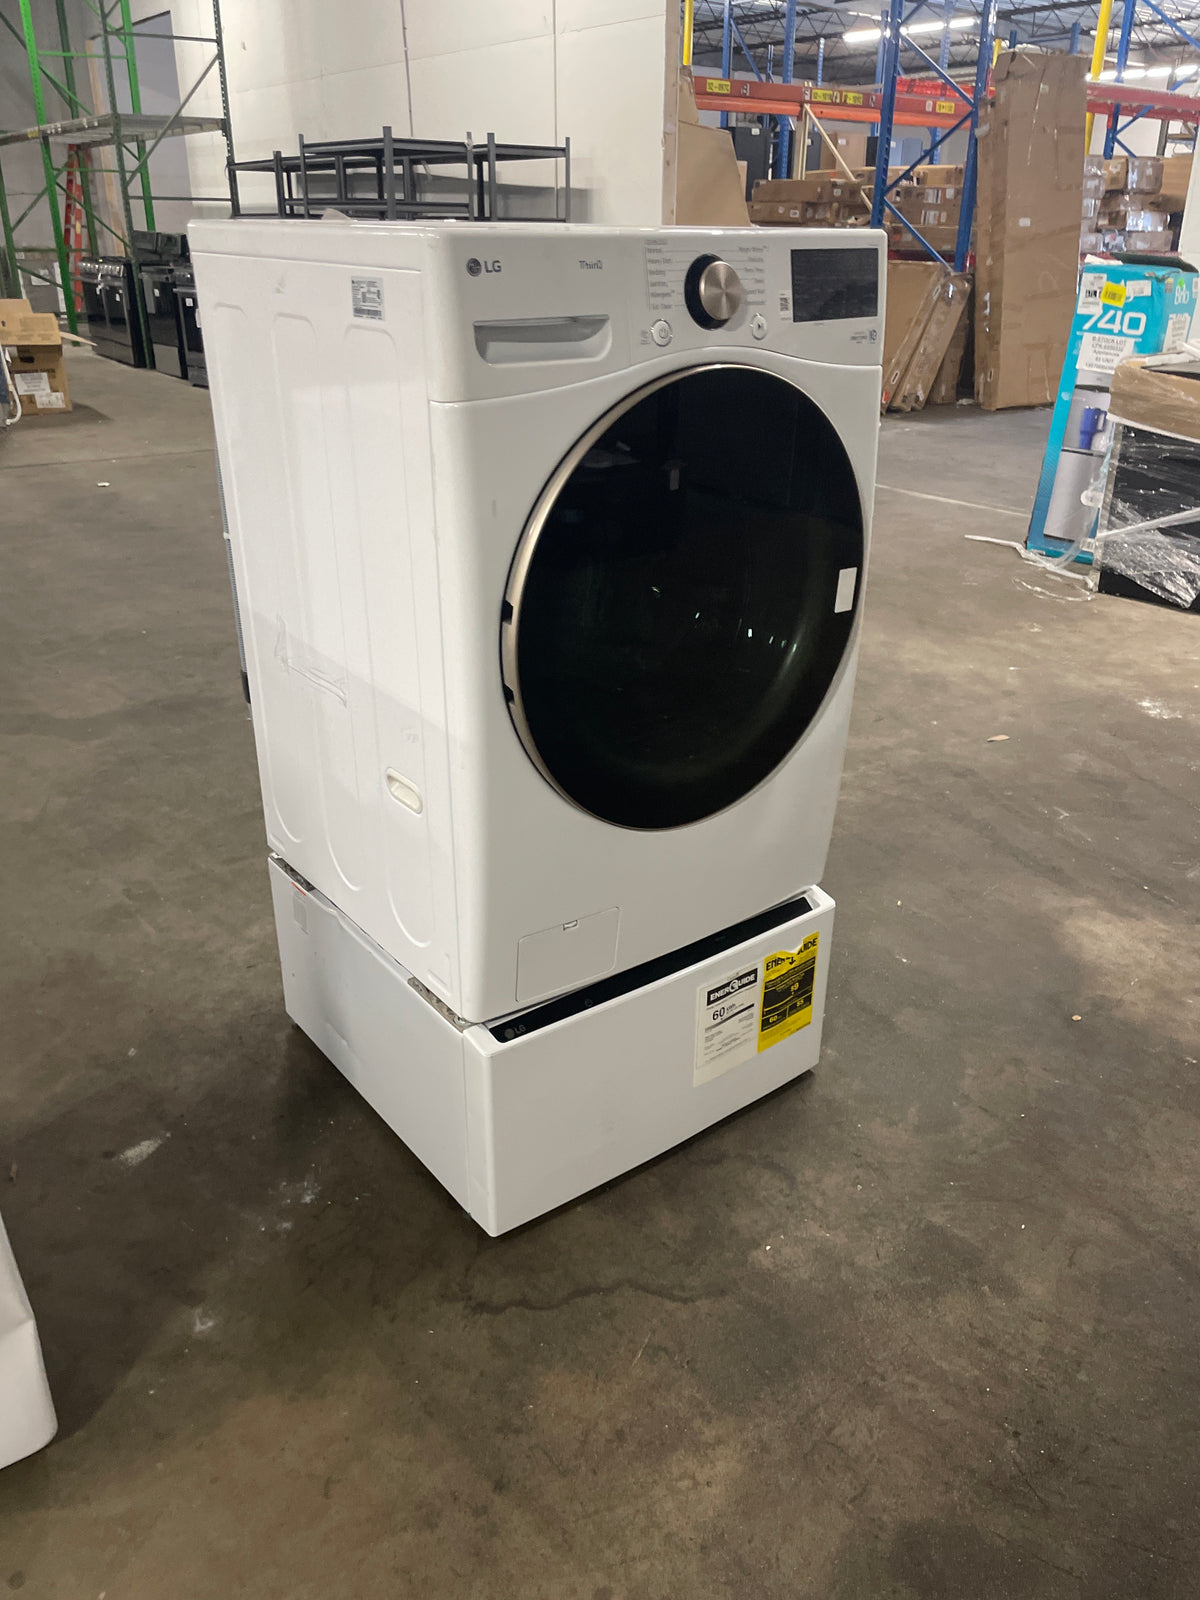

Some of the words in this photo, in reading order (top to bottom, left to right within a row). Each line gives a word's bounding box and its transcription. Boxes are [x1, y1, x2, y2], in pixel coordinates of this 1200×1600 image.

[484, 260, 502, 273] LG
[1082, 310, 1147, 336] 740
[710, 973, 756, 1001] ENERGUIDE
[712, 1006, 725, 1021] 60
[514, 1024, 526, 1034] LG
